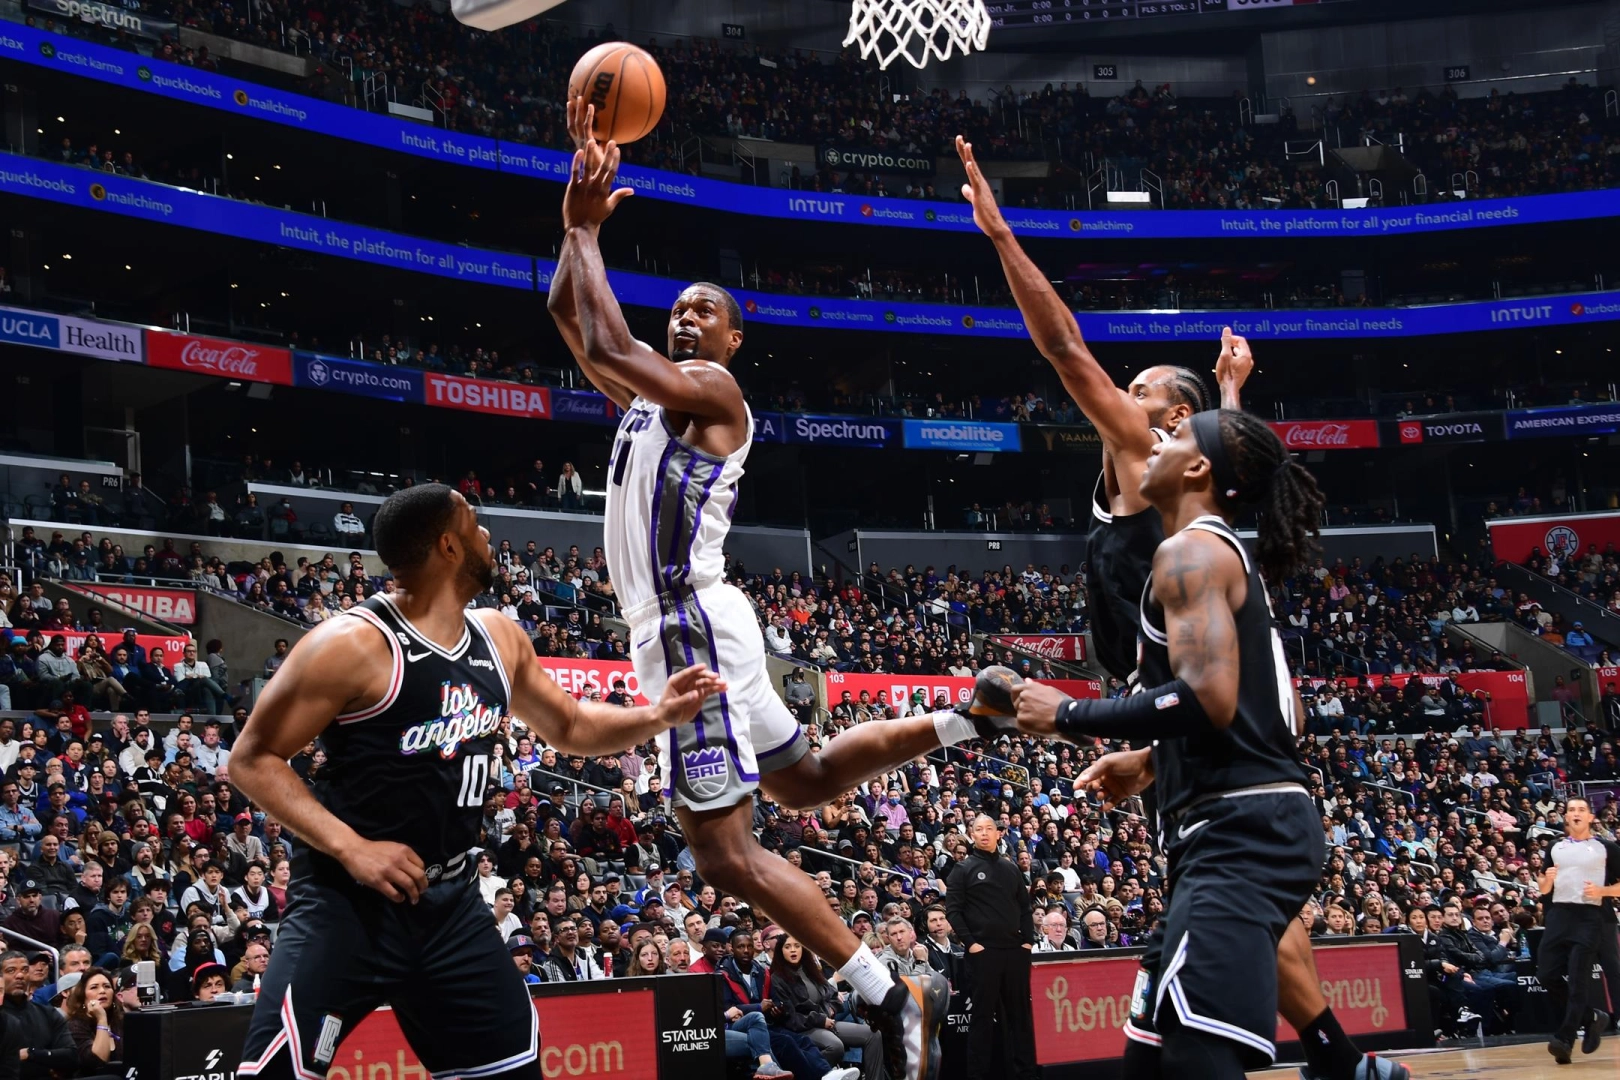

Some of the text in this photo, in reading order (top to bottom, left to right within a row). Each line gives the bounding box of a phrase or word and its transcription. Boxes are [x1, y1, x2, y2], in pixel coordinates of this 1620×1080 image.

[57, 0, 142, 31] Spectrum
[726, 26, 742, 37] 304
[56, 50, 124, 76] credit karma
[1097, 66, 1114, 77] 305
[1447, 67, 1465, 79] 306
[152, 72, 222, 100] quickbooks
[248, 96, 308, 122] mailchimp
[401, 131, 697, 198] Intuit, the platform for all nancial needs
[842, 150, 931, 171] crypto.com
[106, 191, 174, 216] mailchimp
[872, 206, 914, 221] turbotax
[936, 213, 959, 224] credit
[1221, 206, 1519, 235] Intuit, the platform for all your financial needs
[1081, 221, 1133, 236] mailchimp
[280, 221, 323, 246] Intuit,
[325, 230, 351, 250] the
[352, 239, 412, 263] platform
[415, 249, 436, 267] for
[438, 254, 454, 270] all
[456, 259, 489, 278] your
[756, 303, 798, 318] turbotax
[821, 311, 874, 323] credit karma
[895, 315, 953, 328] quickbooks
[974, 319, 1024, 332] mailchimp
[1108, 322, 1146, 338] Intuit,
[1148, 321, 1171, 335] the
[1232, 319, 1251, 333] for
[1255, 319, 1271, 332] all
[1273, 320, 1302, 335] your
[1305, 317, 1360, 332] financial
[1362, 316, 1403, 330] needs
[2, 317, 136, 355] UCLA Health
[332, 369, 412, 392] crypto.com
[430, 378, 546, 414] TOSHIBA
[1514, 412, 1620, 430] AMERICAN EXPRES
[795, 418, 886, 442] Spectrum
[921, 426, 1004, 442] mobilitie
[1060, 432, 1103, 443] YAAMA
[1425, 422, 1483, 438] TOYOTA
[102, 476, 119, 488] PR6
[988, 541, 1001, 550] PR8
[78, 590, 193, 620] SHIBA
[165, 639, 186, 652] 101
[467, 655, 495, 671] honey
[829, 674, 845, 684] 103
[1506, 673, 1524, 683] 104
[1600, 668, 1618, 677] 105
[1087, 681, 1101, 691] 103
[401, 704, 503, 756] angeles
[686, 763, 728, 780] SAC
[456, 754, 488, 808] 10
[1046, 976, 1132, 1033] hone
[1322, 976, 1390, 1028] oney
[661, 1028, 718, 1044] STARLUX
[672, 1041, 711, 1053] AIRLINES
